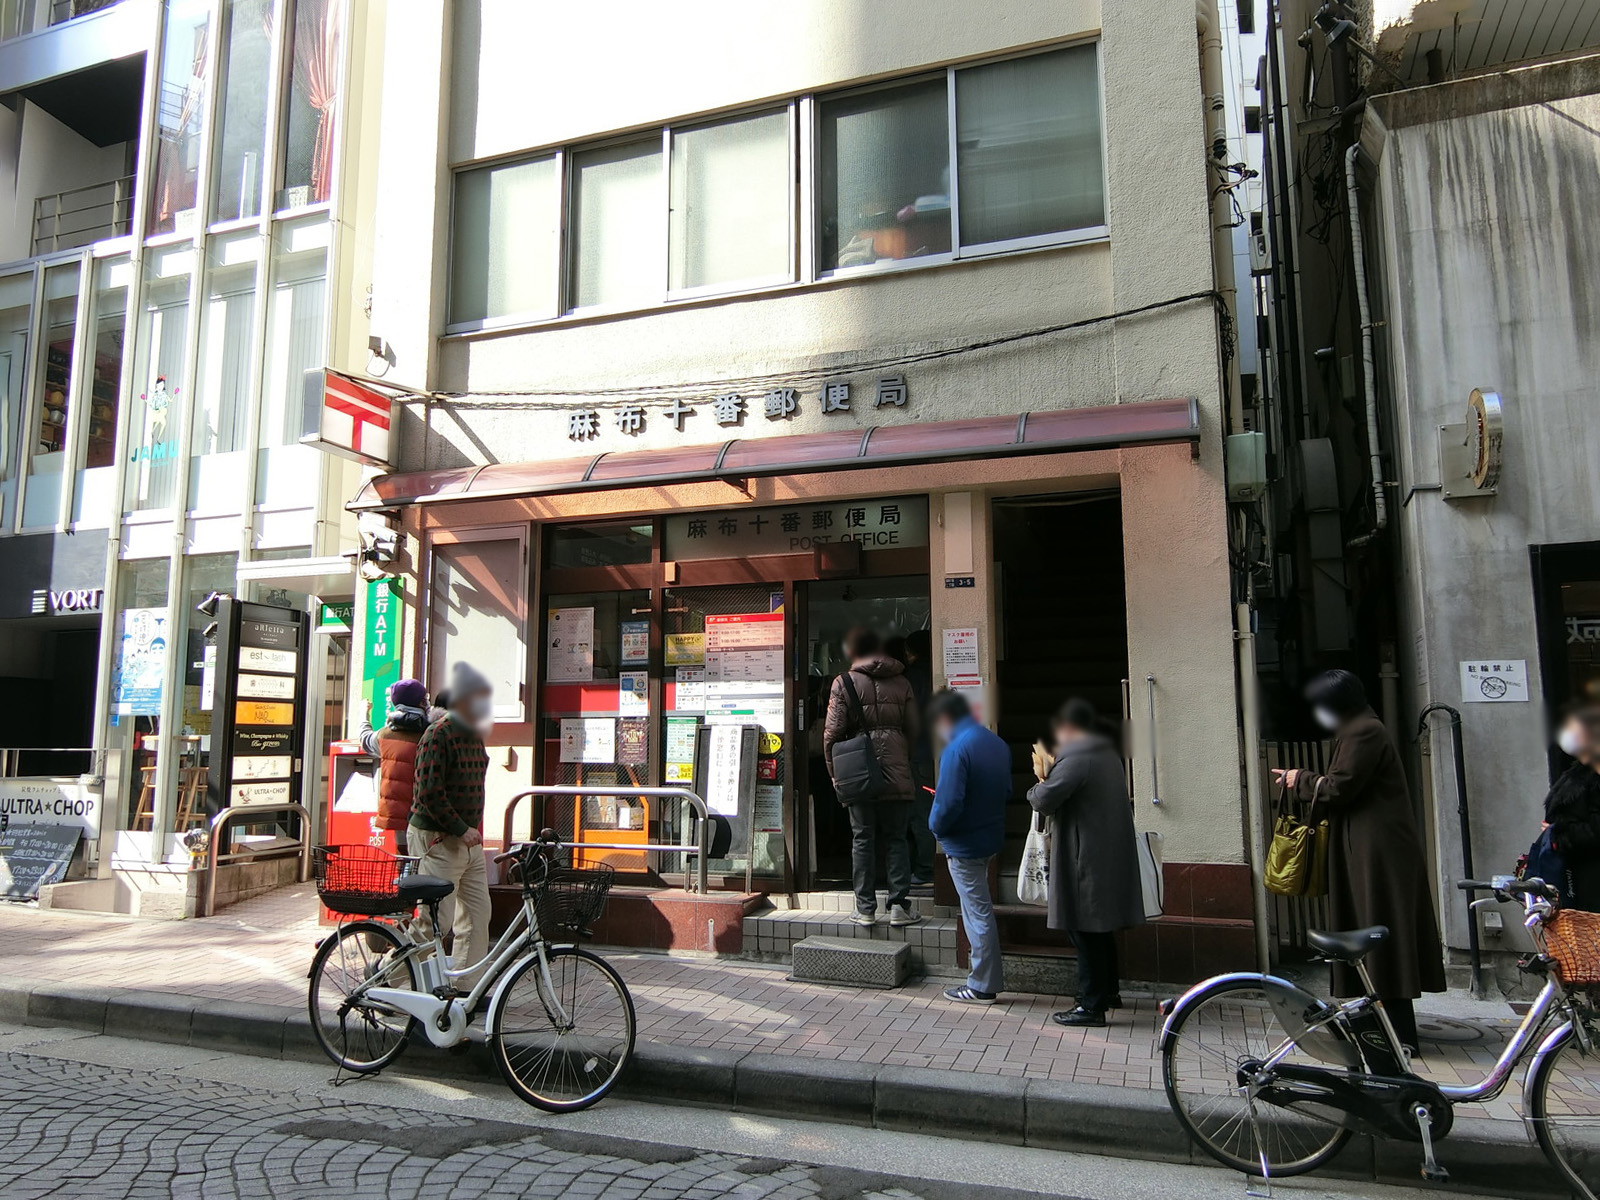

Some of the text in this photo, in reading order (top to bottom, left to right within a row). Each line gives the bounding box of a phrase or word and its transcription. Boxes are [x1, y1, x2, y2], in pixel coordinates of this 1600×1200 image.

[568, 374, 907, 441] 麻布十番郵便局
[131, 440, 179, 462] JAMU
[687, 505, 901, 538] 麻布十番郵便局
[50, 588, 103, 610] VORT
[373, 582, 389, 657] 銀行ATM
[1468, 664, 1514, 673] 駐輪禁止
[2, 798, 95, 816] ULTRA CHOP
[369, 836, 385, 847] POST
